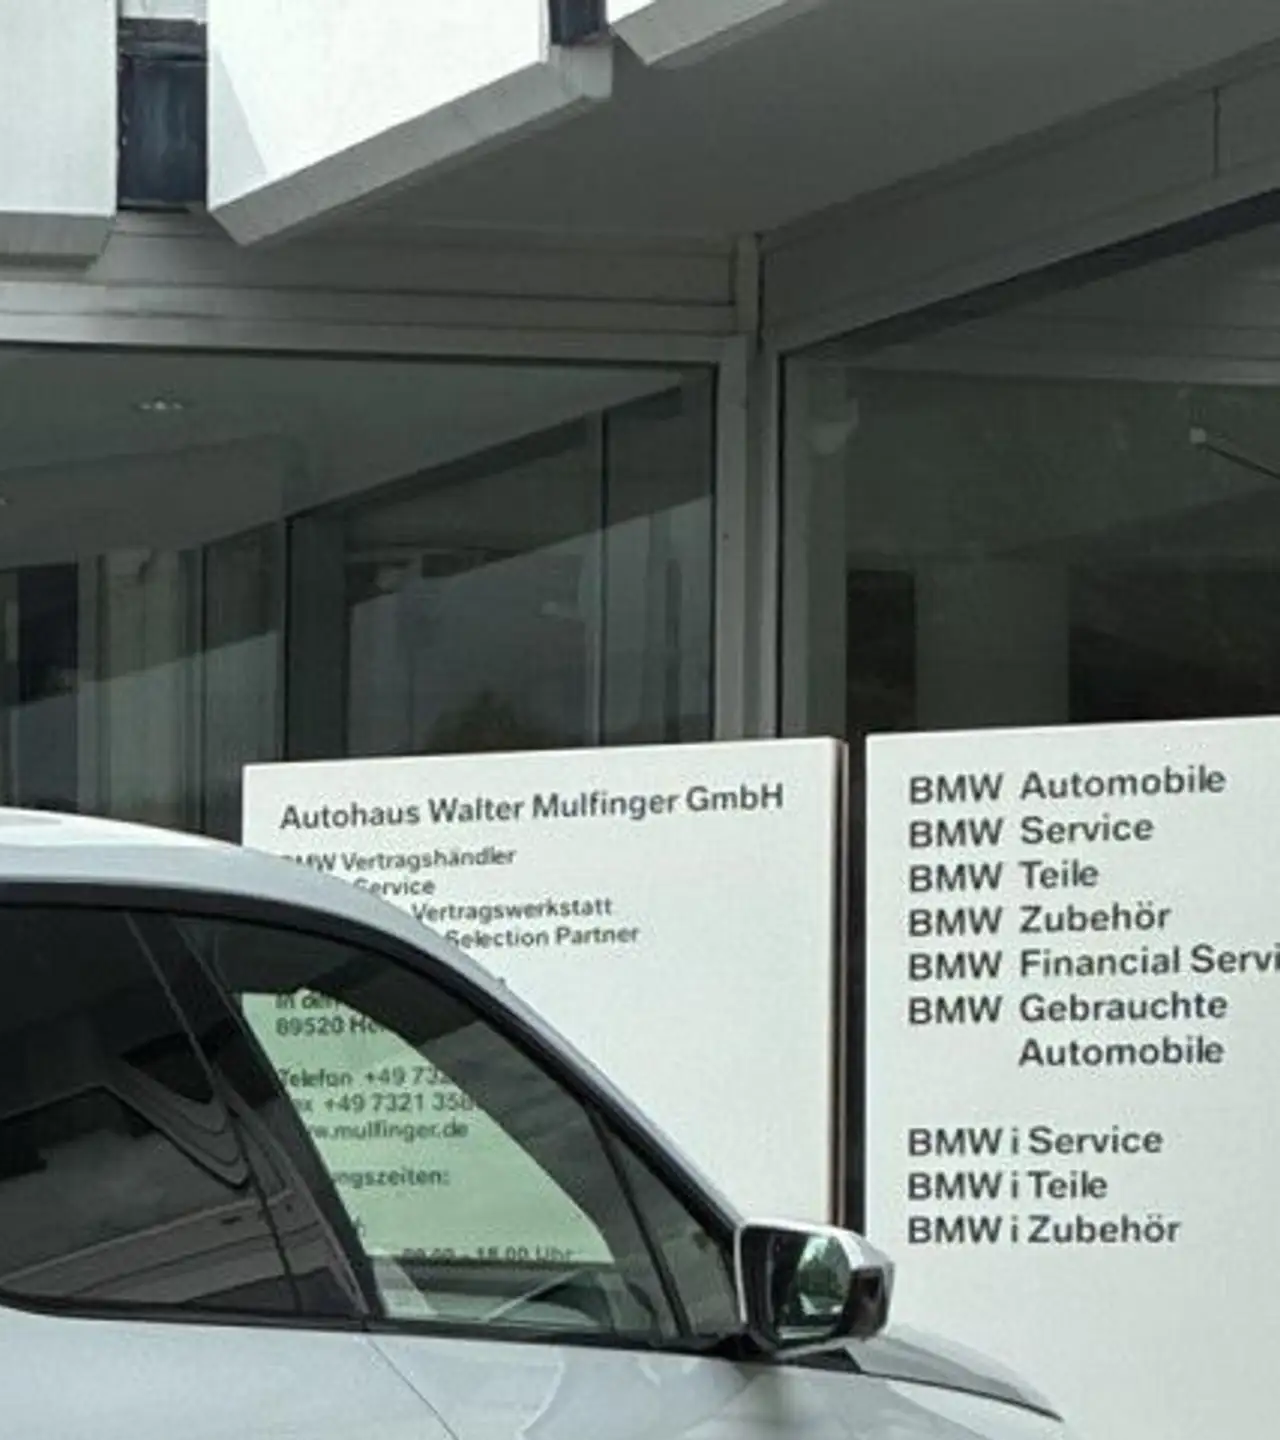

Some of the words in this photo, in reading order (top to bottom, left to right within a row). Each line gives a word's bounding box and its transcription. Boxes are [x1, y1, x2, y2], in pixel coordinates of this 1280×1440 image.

[908, 773, 1004, 805] BMW
[1020, 764, 1228, 800] Automobile
[279, 801, 420, 830] Autohaus
[427, 796, 524, 825] Walter
[532, 789, 680, 823] Mulfinger
[685, 783, 784, 812] GmbH
[908, 817, 1004, 849] BMW
[1020, 813, 1154, 845] Service
[342, 846, 517, 873] Vertragshändler
[908, 861, 1004, 892] BMW
[1020, 859, 1100, 889] Teile
[411, 897, 613, 925] Vertragswerkstatt
[908, 906, 1004, 937] BMW
[1020, 901, 1173, 933] Zubehör
[555, 925, 641, 947] Partner
[908, 951, 1004, 982] BMW
[1020, 945, 1181, 978] Financial
[908, 995, 1004, 1026] BMW
[1020, 990, 1229, 1025] Gebrauchte
[1019, 1035, 1226, 1067] Automobile
[908, 1127, 1004, 1157] BMW
[1010, 1126, 1020, 1155] i
[1027, 1123, 1164, 1155] Service
[908, 1171, 1004, 1201] BMW
[1010, 1171, 1020, 1200] i
[1027, 1169, 1108, 1200] Teile
[908, 1216, 1004, 1246] BMW
[1010, 1215, 1020, 1245] i
[1027, 1212, 1181, 1245] Zubehör
